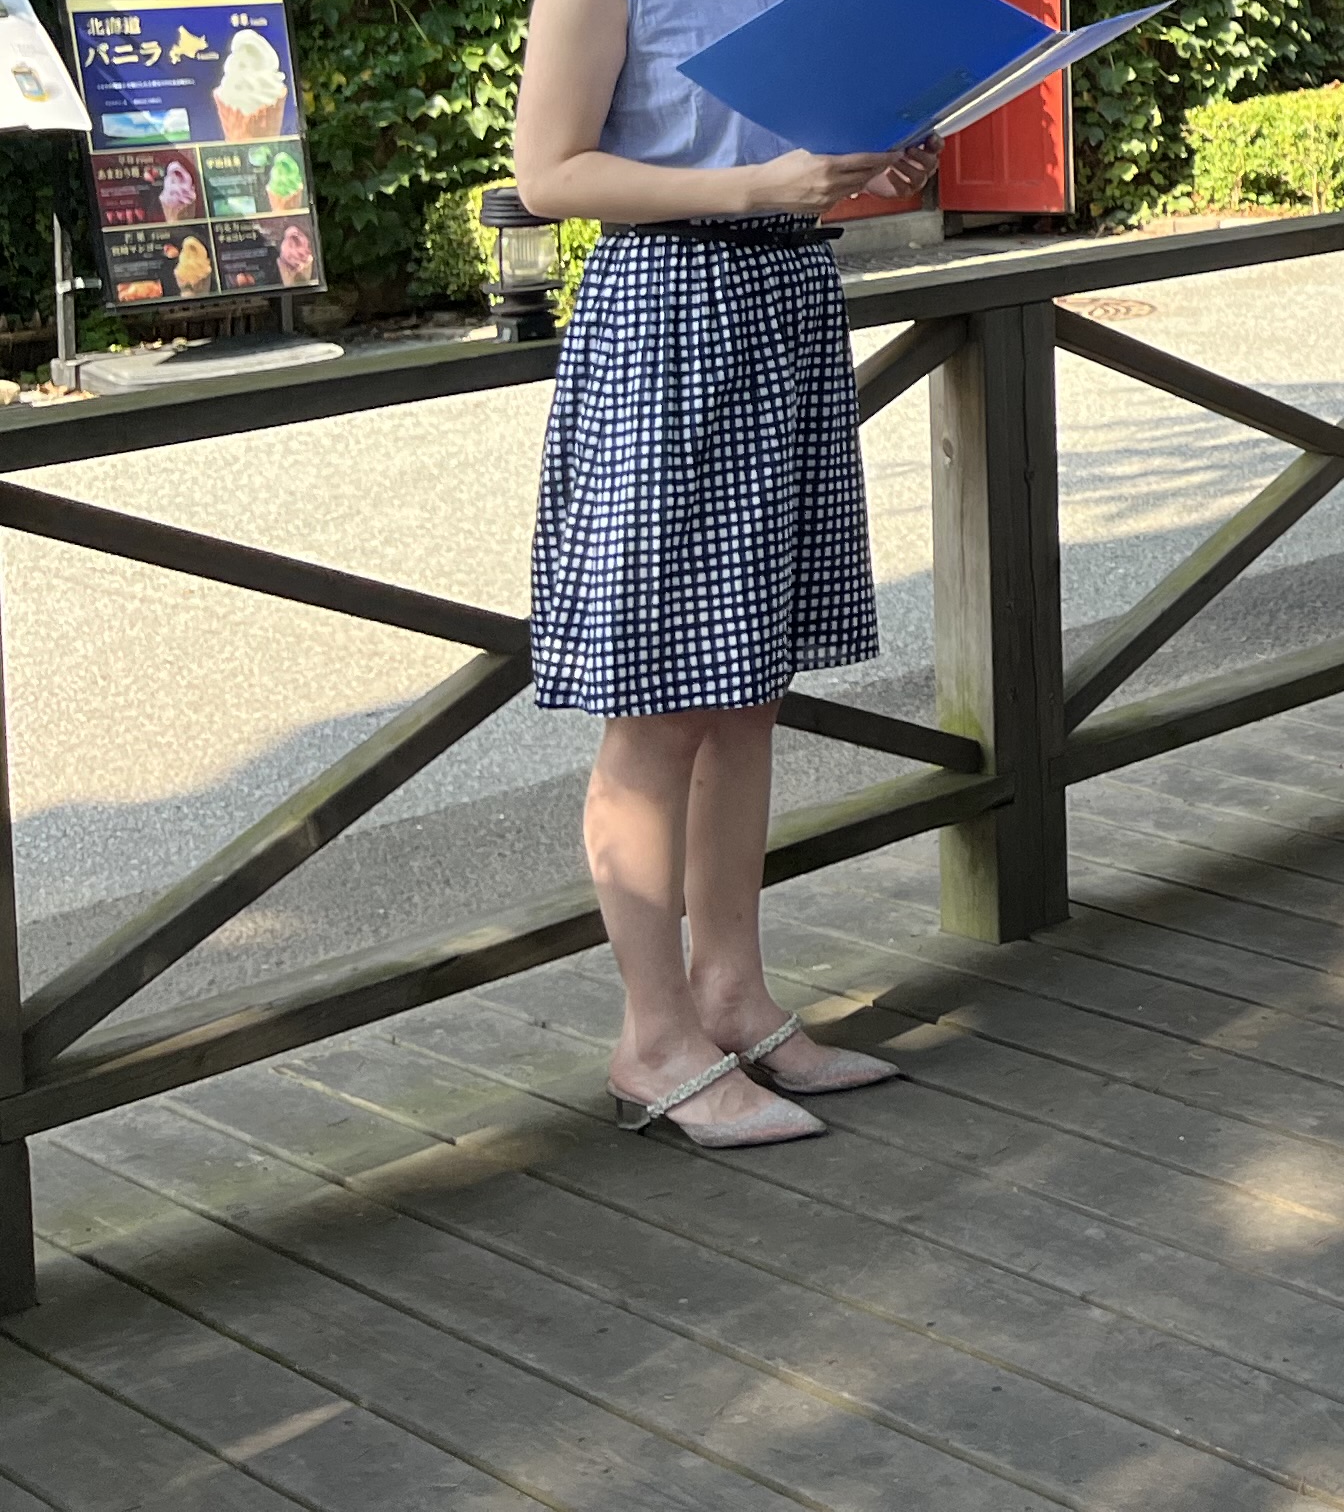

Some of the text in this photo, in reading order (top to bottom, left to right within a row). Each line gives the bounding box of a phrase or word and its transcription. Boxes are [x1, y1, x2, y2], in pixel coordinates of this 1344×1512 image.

[86, 15, 142, 37] 北海道
[84, 40, 163, 68] バニラ
